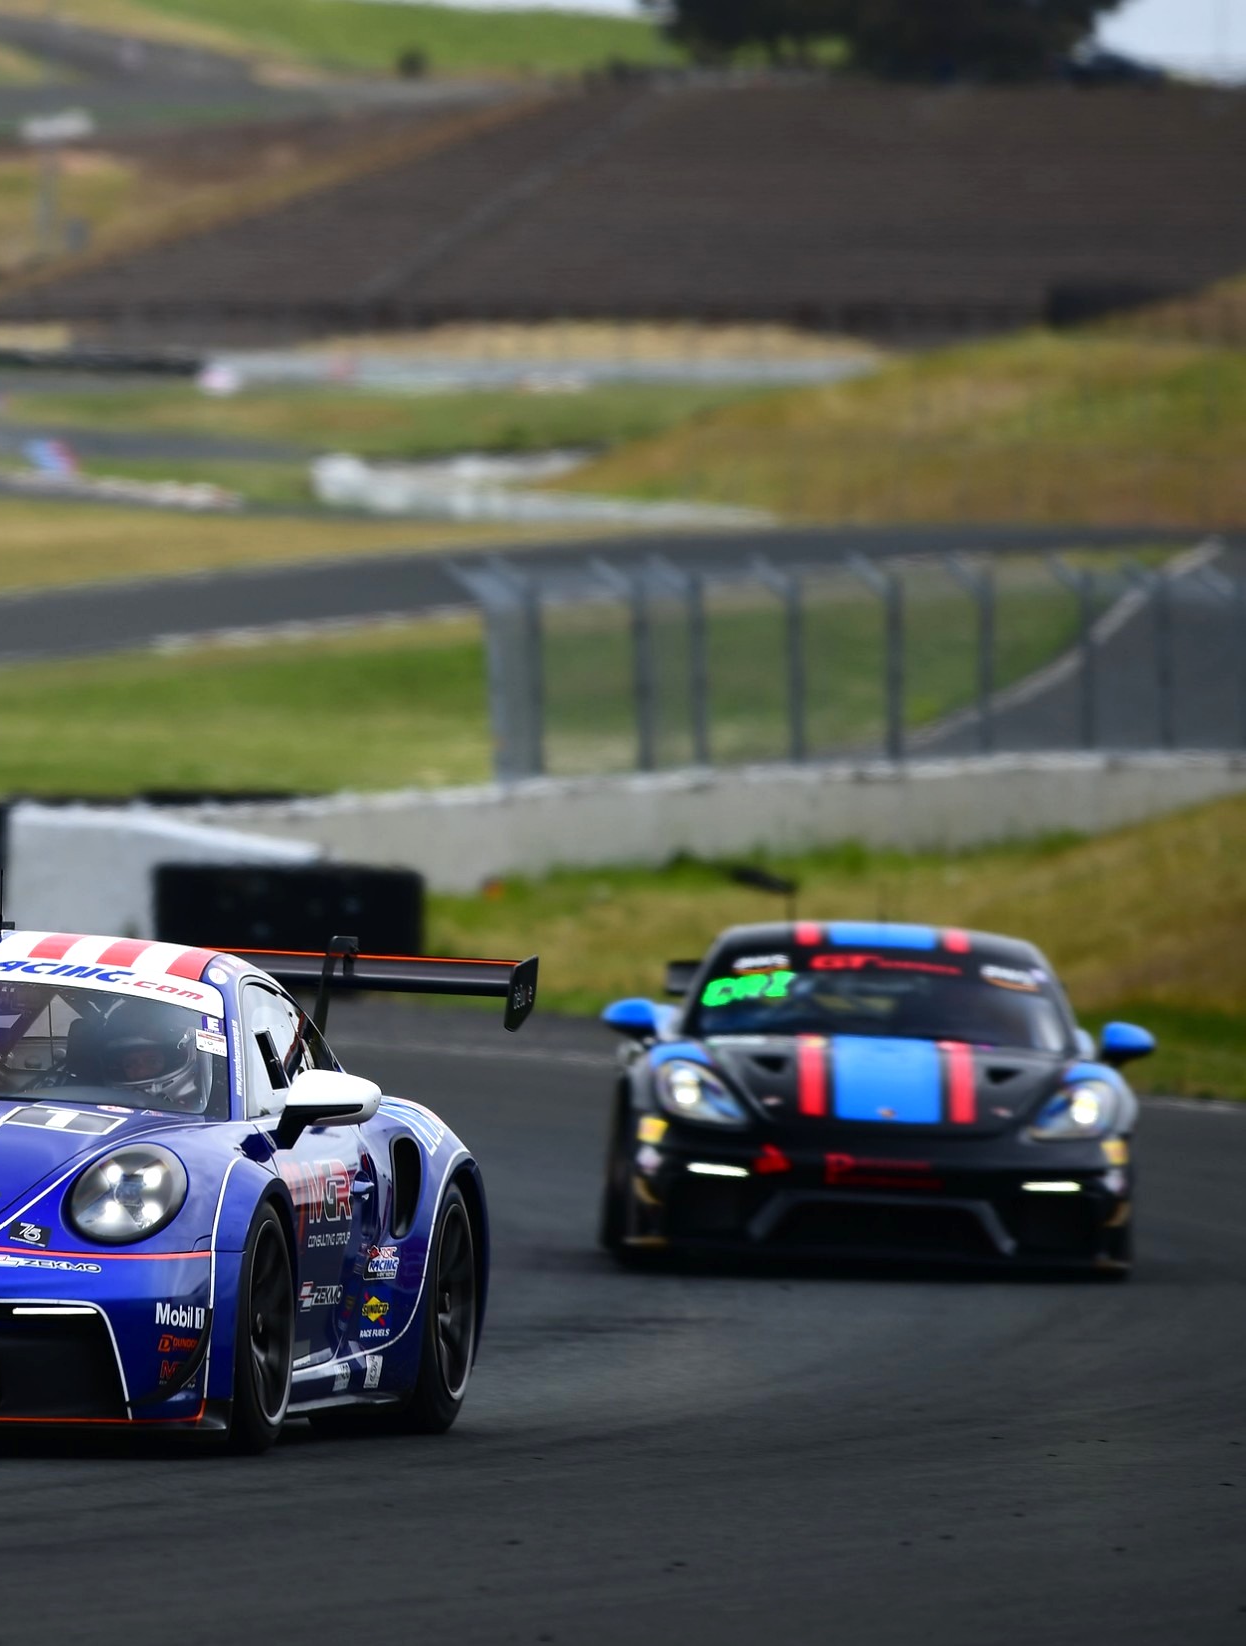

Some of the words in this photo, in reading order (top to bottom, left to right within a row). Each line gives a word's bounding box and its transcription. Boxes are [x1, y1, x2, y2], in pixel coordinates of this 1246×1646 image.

[306, 1158, 353, 1224] MGR
[307, 1234, 335, 1248] CONSULTING
[335, 1231, 351, 1245] GROUP
[24, 1259, 101, 1273] ZEKMO
[369, 1259, 398, 1272] RACING
[312, 1285, 343, 1305] ZEKMO
[155, 1302, 194, 1328] Mobil
[362, 1303, 389, 1315] SUNOCO
[360, 1330, 373, 1339] RACE
[372, 1328, 390, 1338] FUELS
